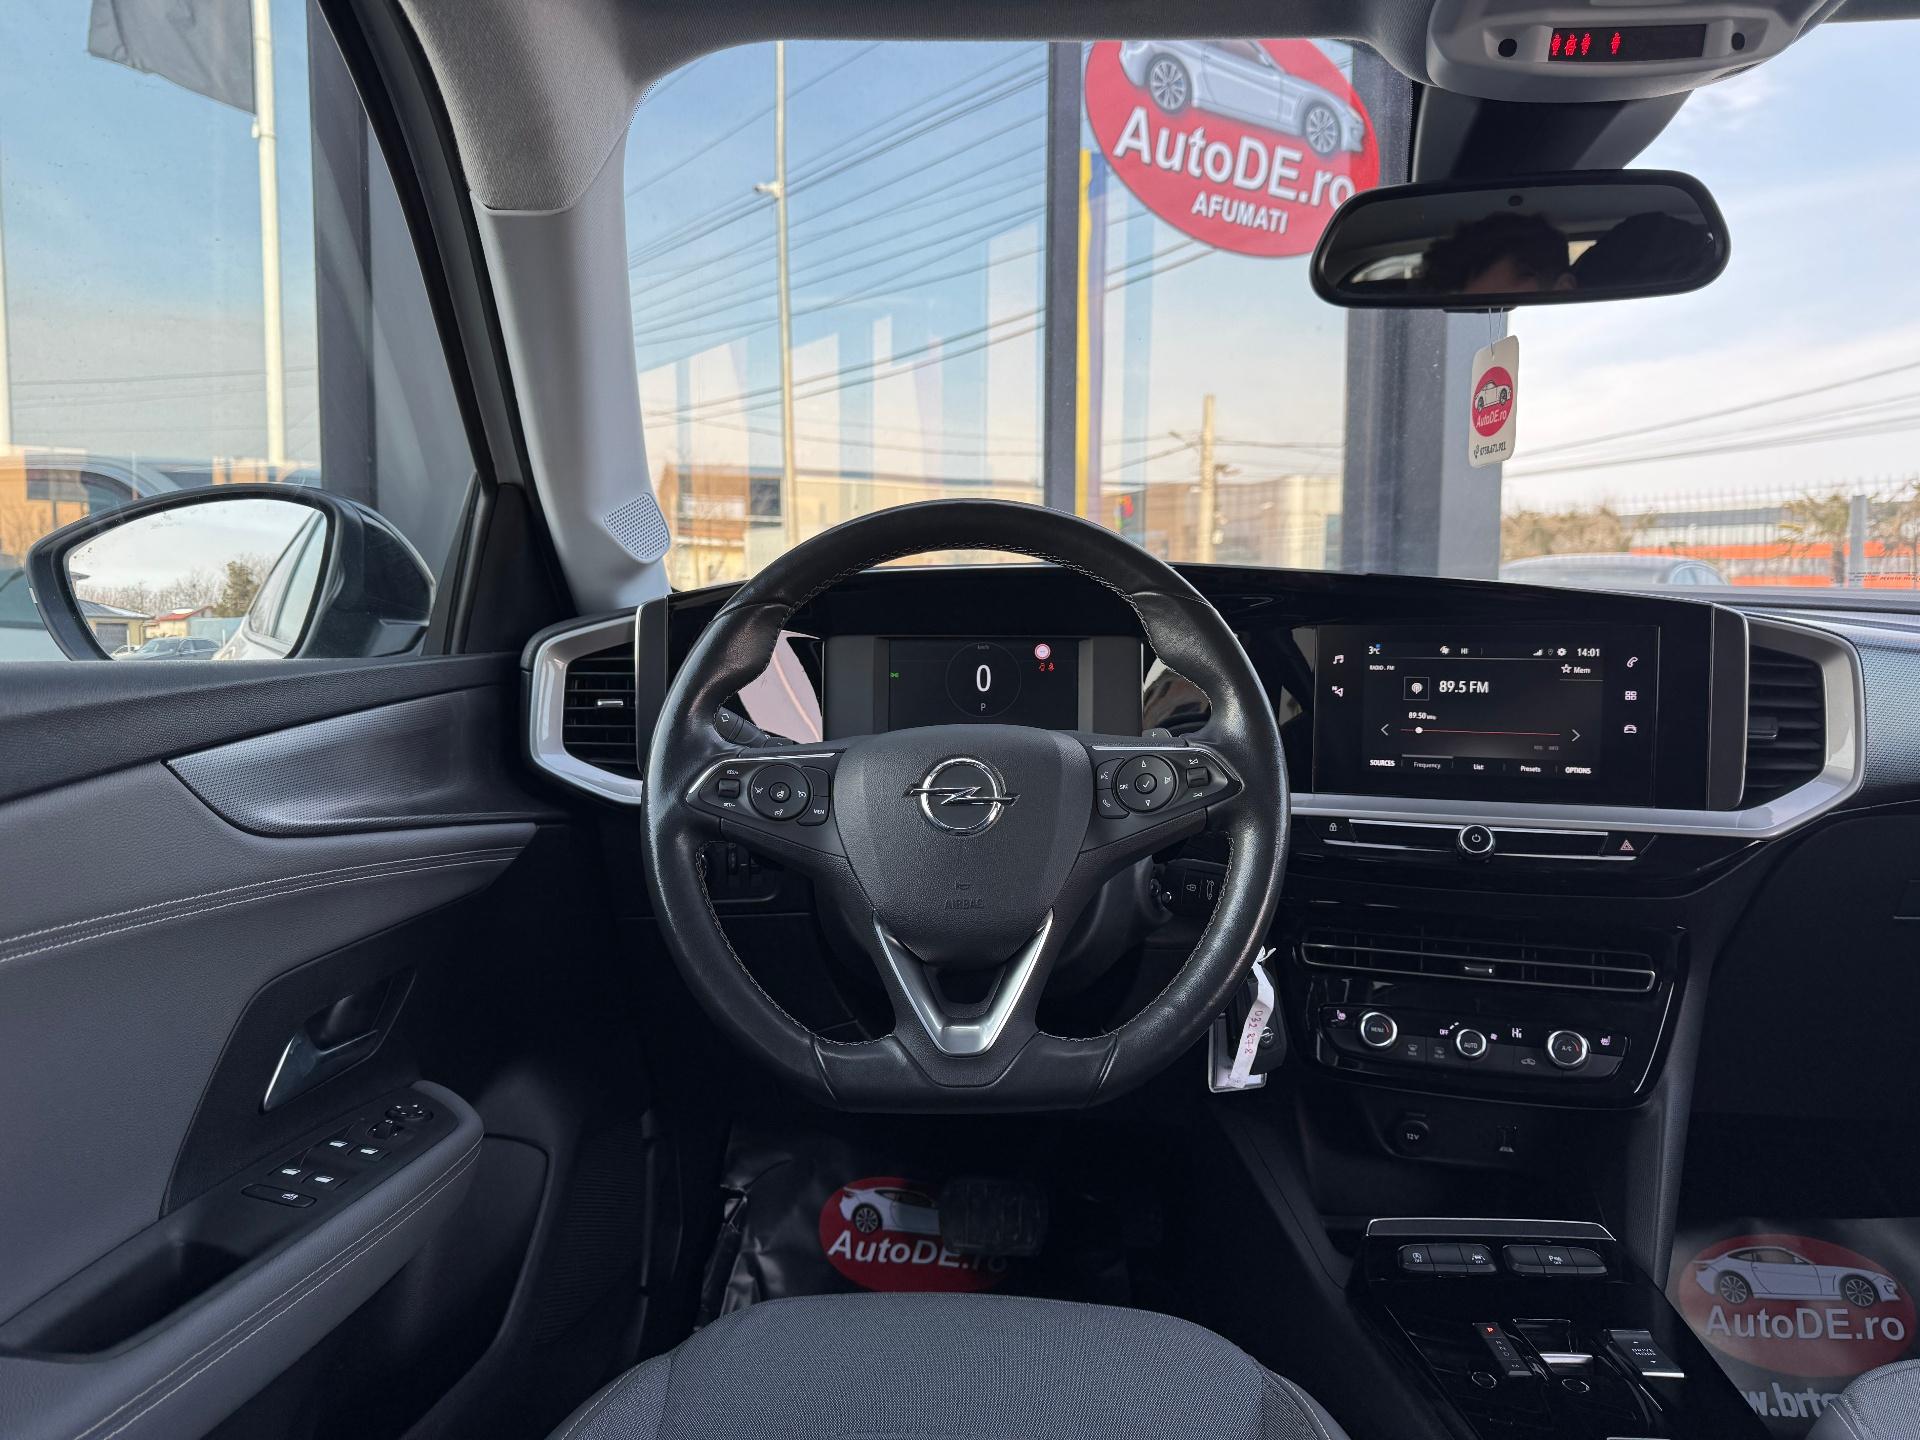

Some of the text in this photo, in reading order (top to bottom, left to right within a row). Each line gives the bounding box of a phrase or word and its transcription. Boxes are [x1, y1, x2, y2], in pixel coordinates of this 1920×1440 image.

[1112, 106, 1356, 211] AutoDE.ro
[1191, 191, 1289, 234] AFUMATI
[1577, 648, 1600, 657] 14:01
[976, 664, 991, 692] 0
[1439, 680, 1489, 693] 89.5 FM
[980, 702, 986, 711] P
[1413, 761, 1441, 769] Frequency
[1520, 765, 1542, 773] Presets
[1565, 766, 1592, 774] OPTIONS
[1705, 1304, 1906, 1341] AutoDE.ro
